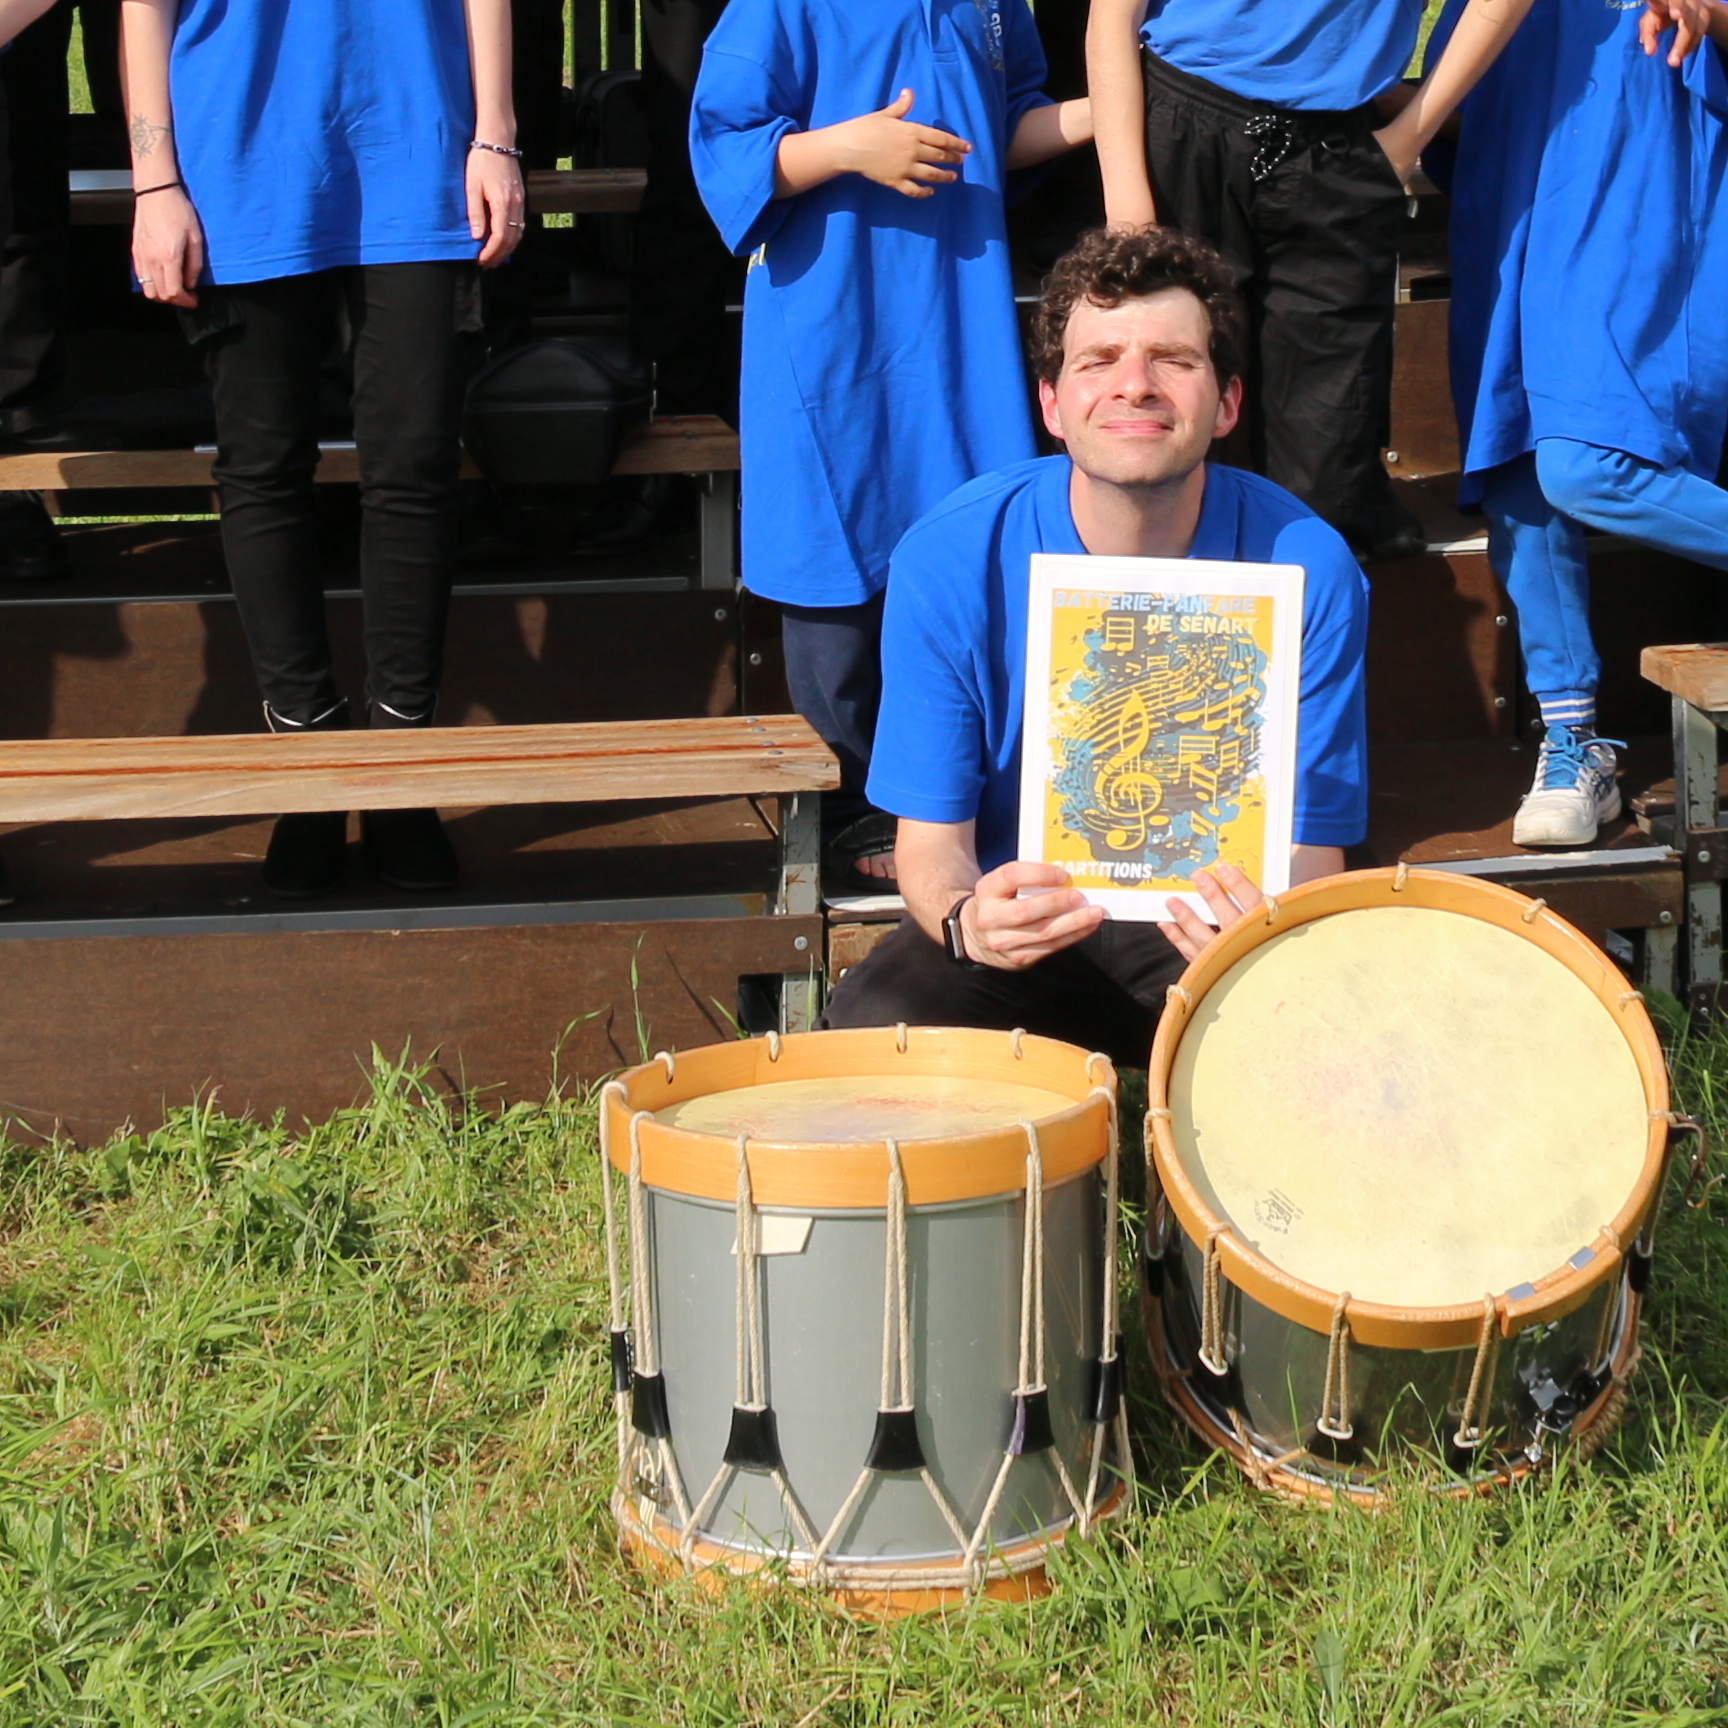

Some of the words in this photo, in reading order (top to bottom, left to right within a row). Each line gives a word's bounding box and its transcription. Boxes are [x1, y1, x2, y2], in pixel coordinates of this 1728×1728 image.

[1055, 591, 1255, 614] BATTERIE-FANFARE
[1146, 615, 1174, 632] DE
[1178, 611, 1257, 634] SÉNART
